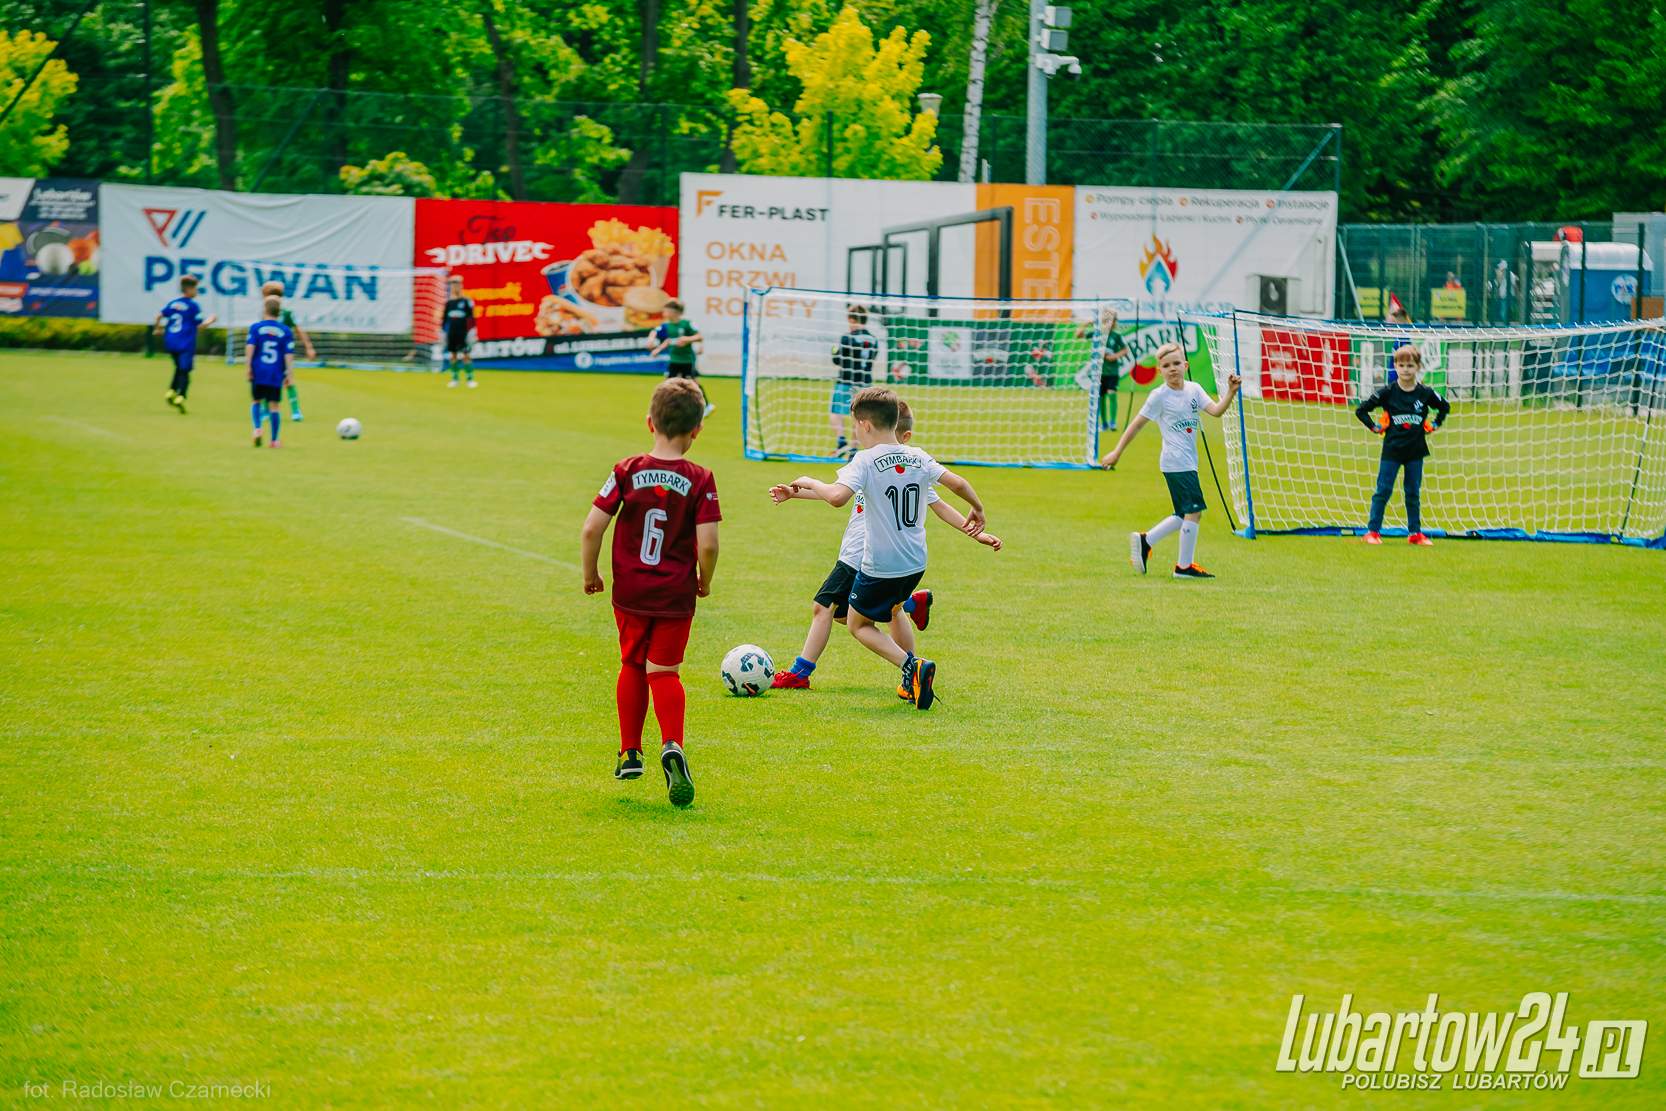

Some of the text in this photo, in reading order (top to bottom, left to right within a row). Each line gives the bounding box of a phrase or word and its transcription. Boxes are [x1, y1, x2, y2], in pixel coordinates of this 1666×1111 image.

[718, 204, 829, 221] FER-PLAST
[706, 241, 788, 262] OKNA
[144, 256, 379, 301] PEGWAN
[706, 269, 797, 288] DRZWI
[169, 313, 183, 333] 3
[261, 341, 278, 364] 5
[635, 472, 690, 493] TYMBARK
[885, 483, 920, 531] 10
[640, 508, 667, 566] 6
